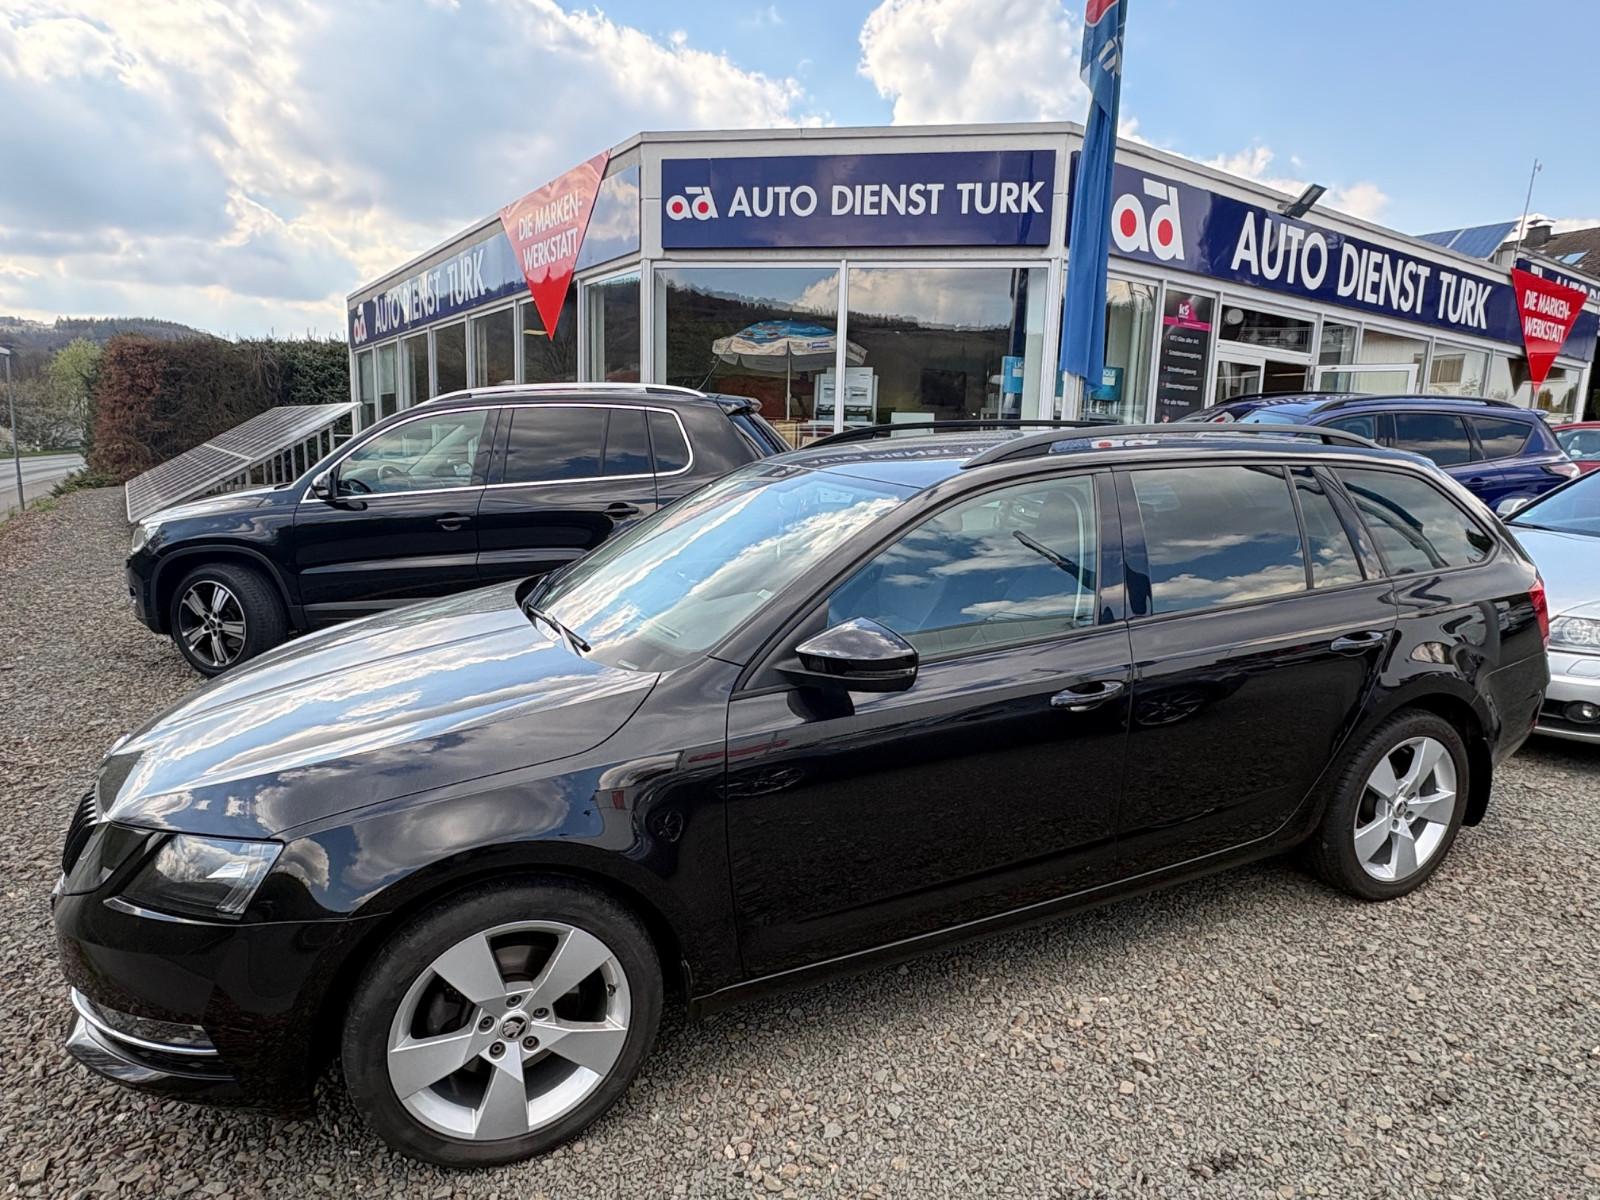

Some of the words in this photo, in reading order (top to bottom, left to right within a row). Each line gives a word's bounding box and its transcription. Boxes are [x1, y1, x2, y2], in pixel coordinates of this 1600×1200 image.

[518, 213, 533, 241] DIE
[535, 190, 582, 236] MARKEN-
[728, 185, 818, 218] AUTO
[831, 183, 944, 217] DIENST
[957, 181, 1044, 215] TURK
[523, 227, 578, 271] WERKSTATT
[1231, 211, 1327, 290] AUTO
[1337, 242, 1431, 314] DIENST
[1437, 271, 1492, 329] TURK
[372, 290, 400, 334] AUTO
[402, 271, 440, 324] DIENST
[447, 248, 485, 307] TURK
[1523, 289, 1538, 310] DIE
[1537, 293, 1571, 320] MARKEN-
[1524, 315, 1566, 343] WERKSTATT
